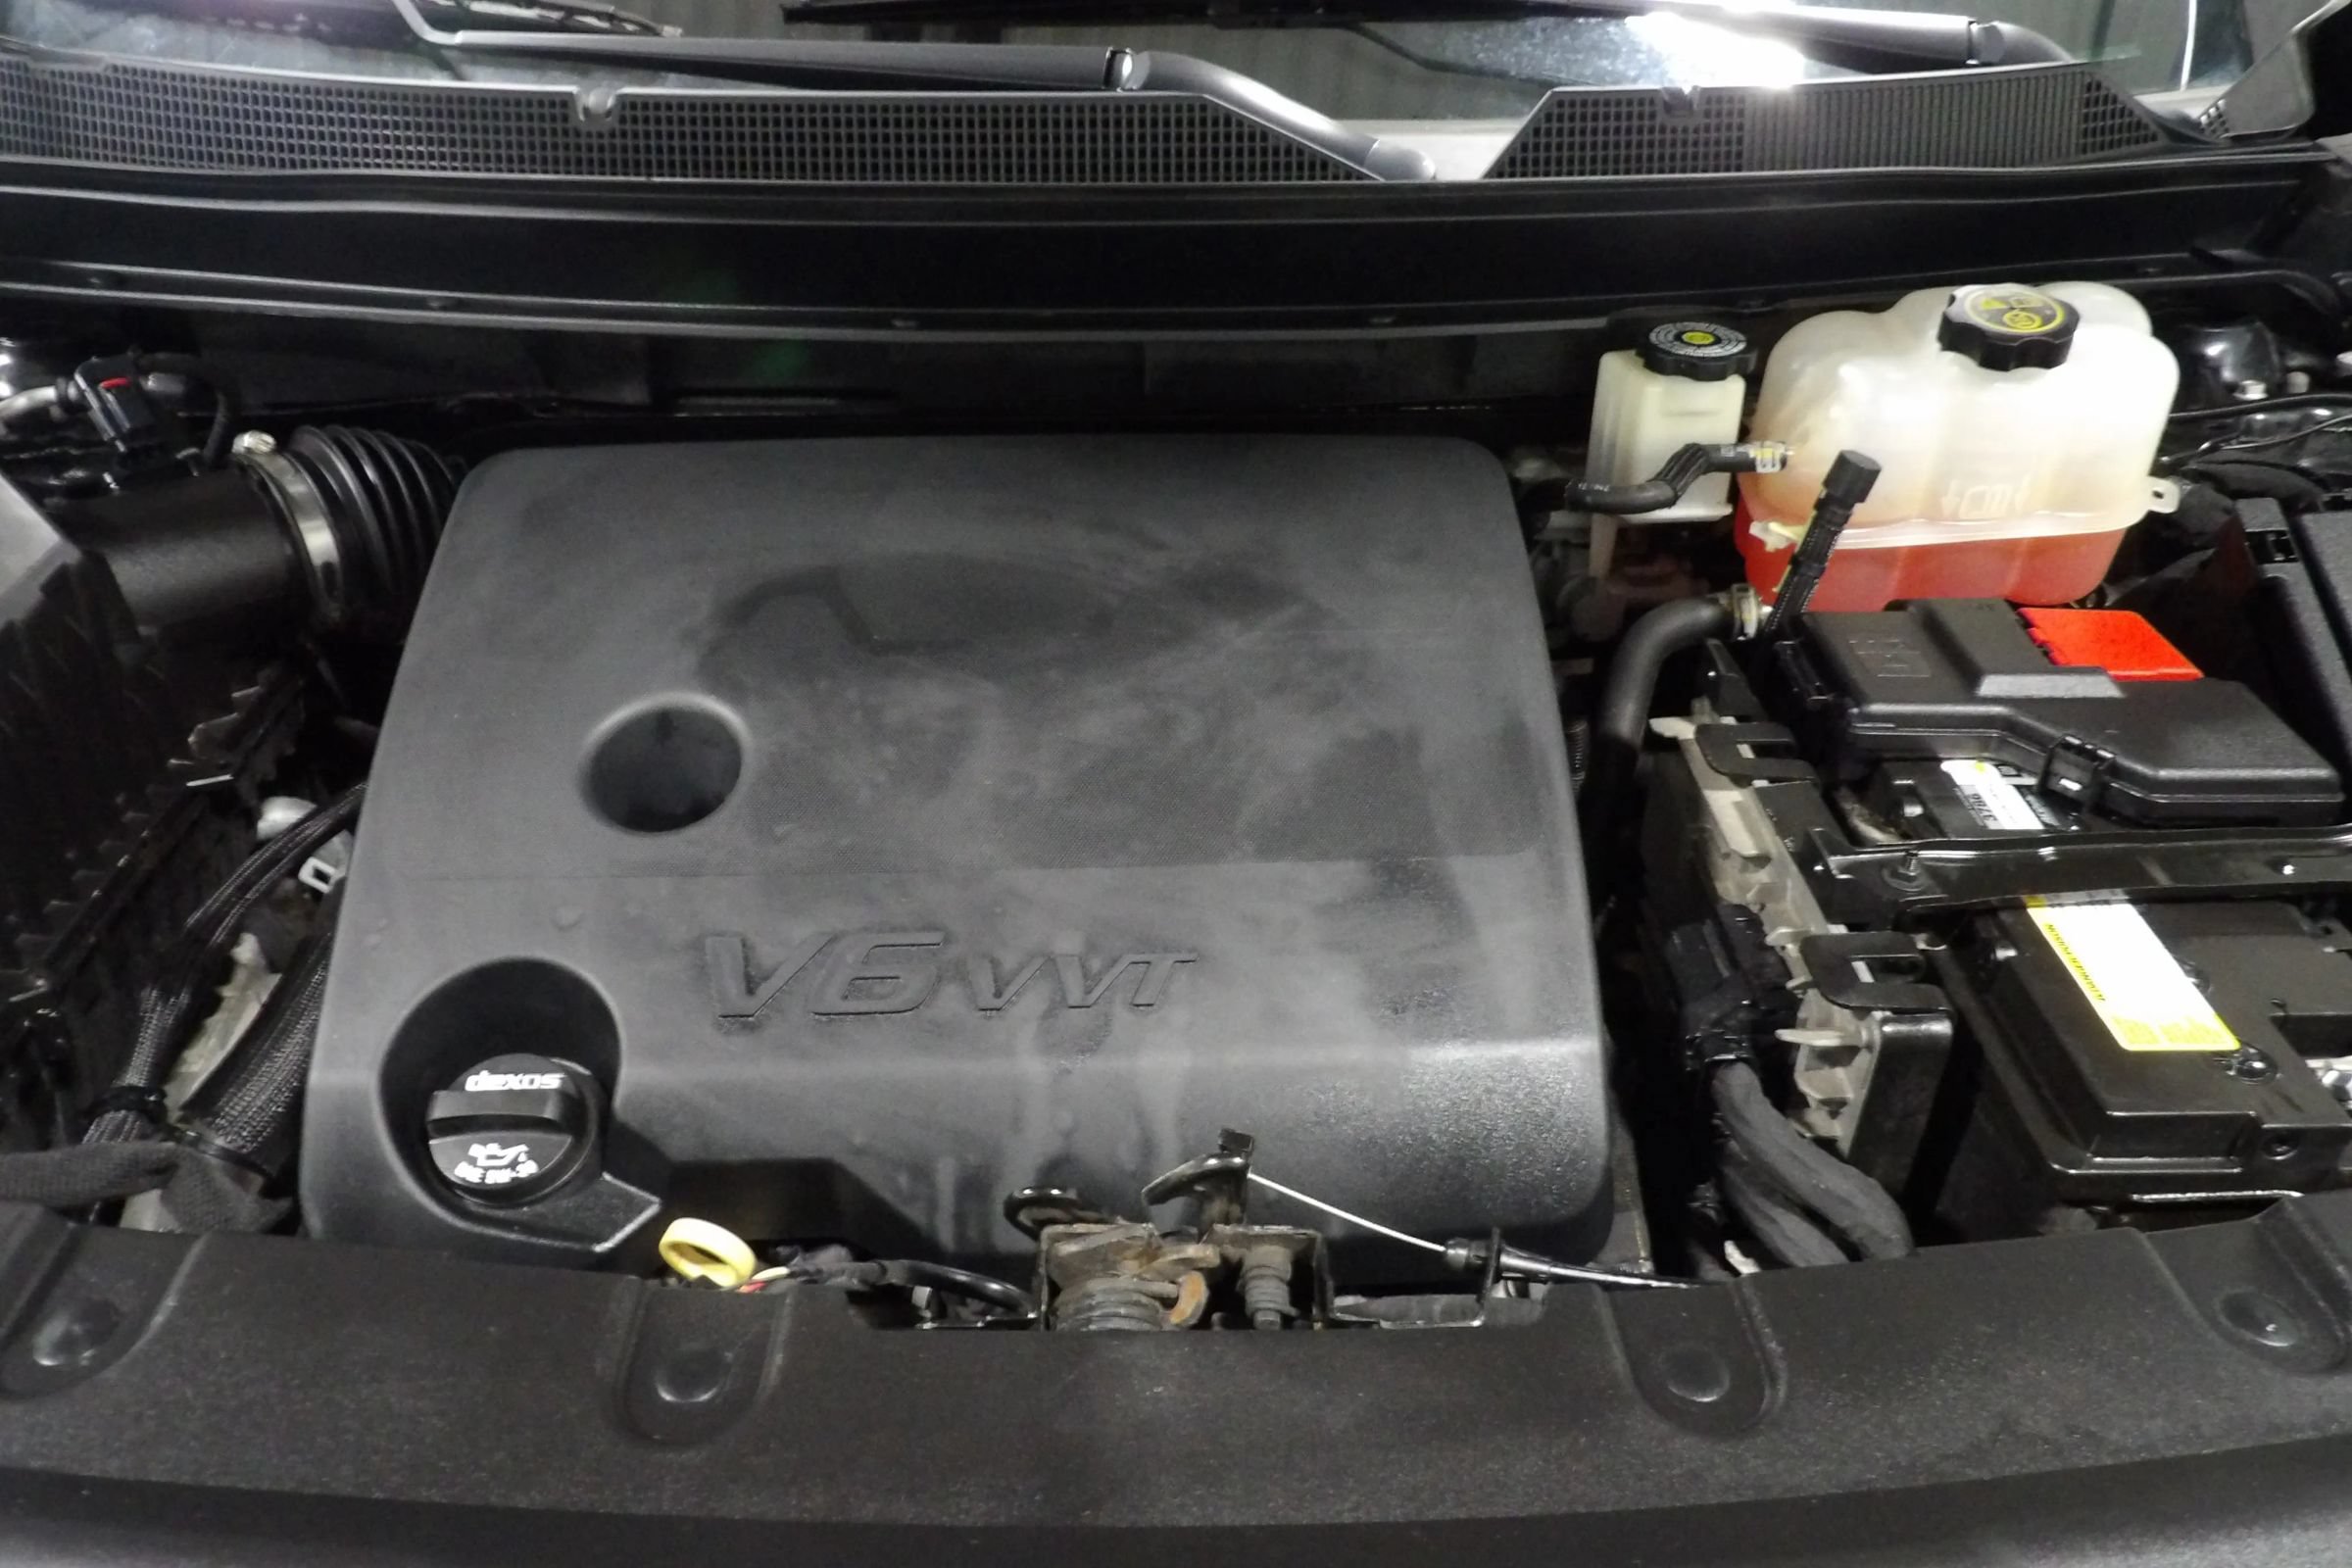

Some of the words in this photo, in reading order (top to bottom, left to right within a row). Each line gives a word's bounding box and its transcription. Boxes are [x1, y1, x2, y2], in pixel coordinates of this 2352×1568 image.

[704, 930, 947, 1019] V6
[967, 951, 1199, 1011] VVT
[465, 1070, 566, 1092] dexos
